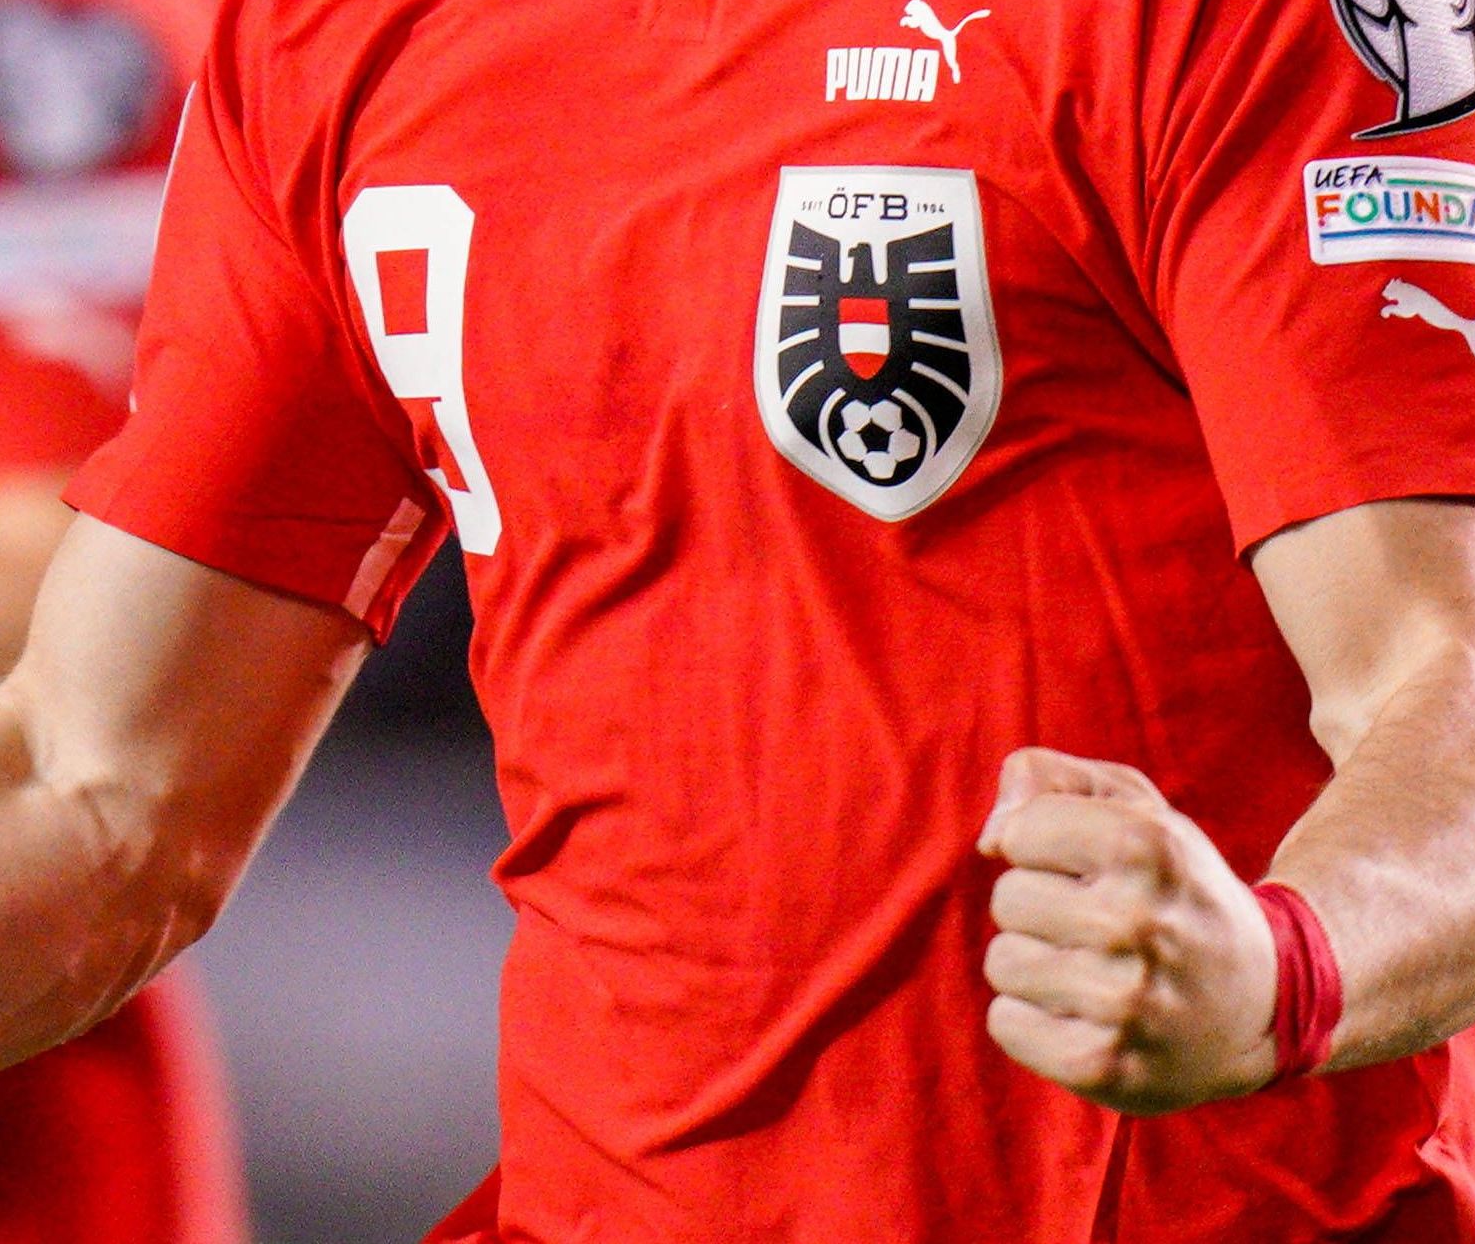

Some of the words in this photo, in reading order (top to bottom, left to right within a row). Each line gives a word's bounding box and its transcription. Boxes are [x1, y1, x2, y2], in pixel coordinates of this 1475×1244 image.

[825, 46, 940, 102] PUMA
[1314, 165, 1383, 188] UEFA
[827, 186, 908, 221] ÖFB
[342, 184, 503, 557] 9
